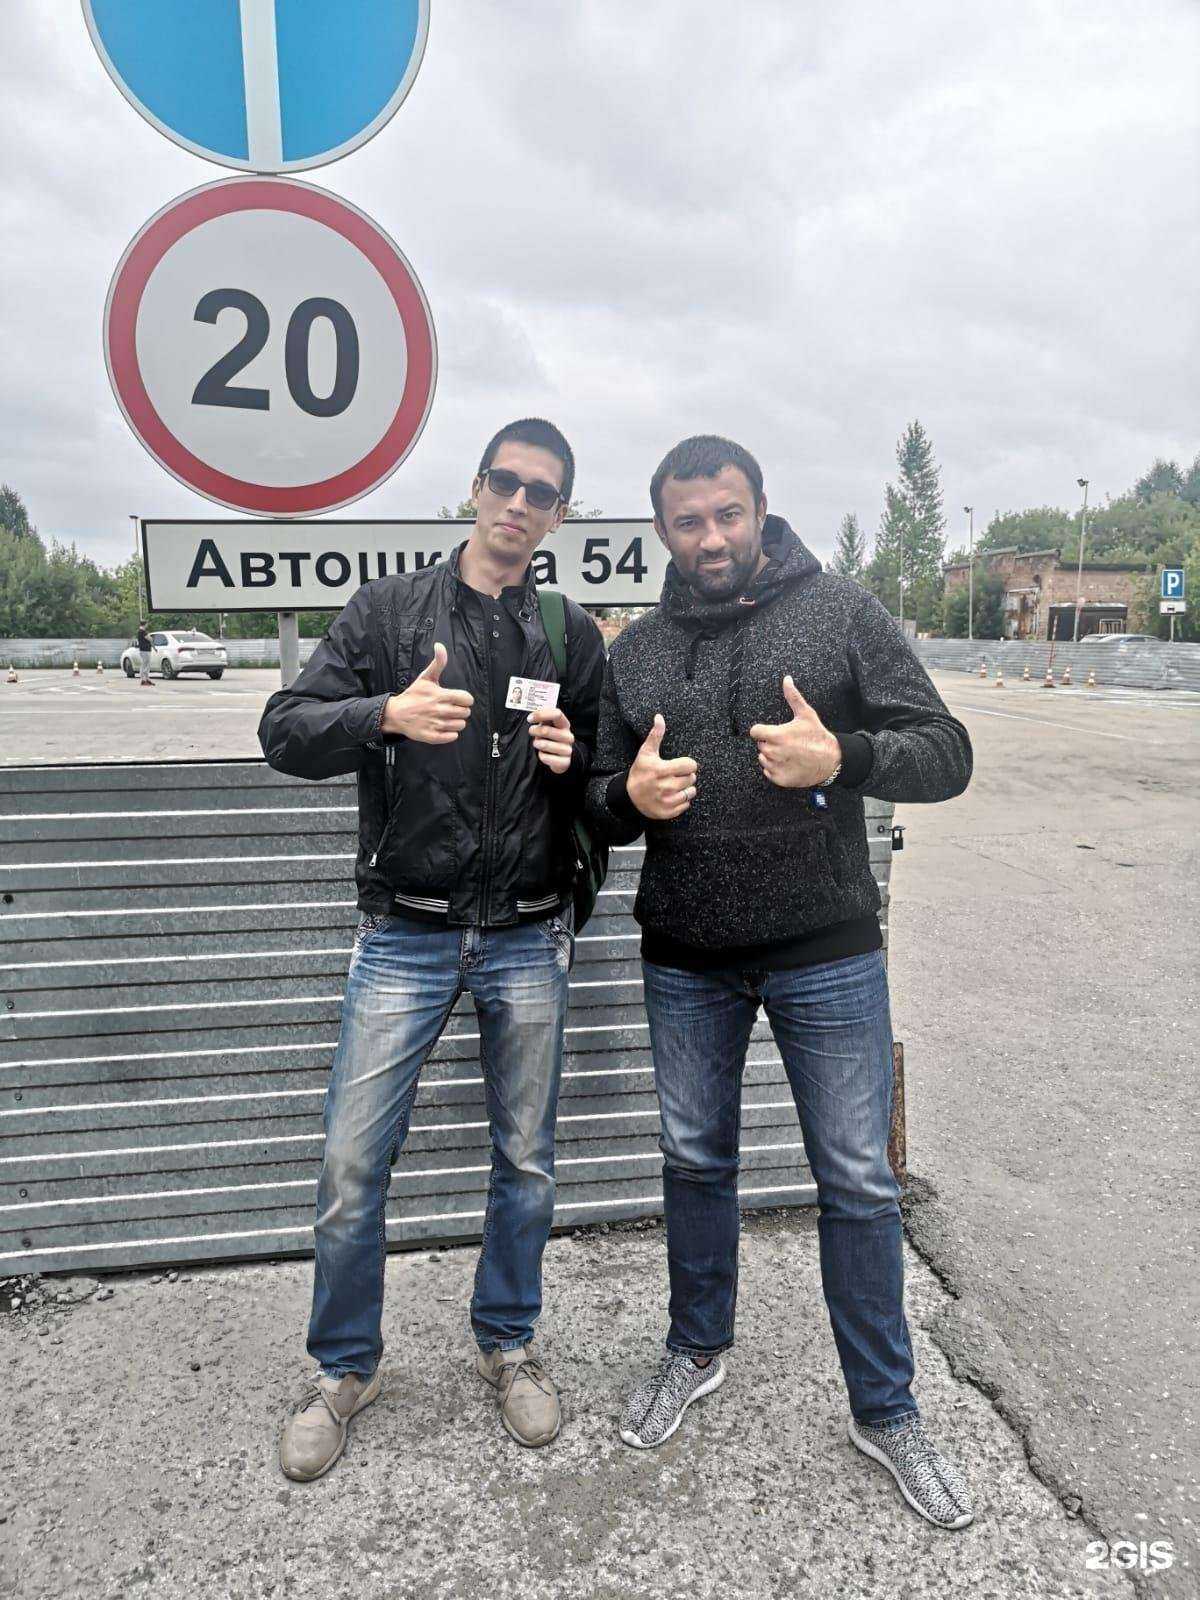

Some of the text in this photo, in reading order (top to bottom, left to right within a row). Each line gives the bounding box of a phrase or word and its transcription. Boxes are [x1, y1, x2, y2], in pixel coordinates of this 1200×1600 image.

[191, 288, 360, 418] 20
[186, 537, 648, 588] Автоша 54
[1167, 572, 1180, 595] P
